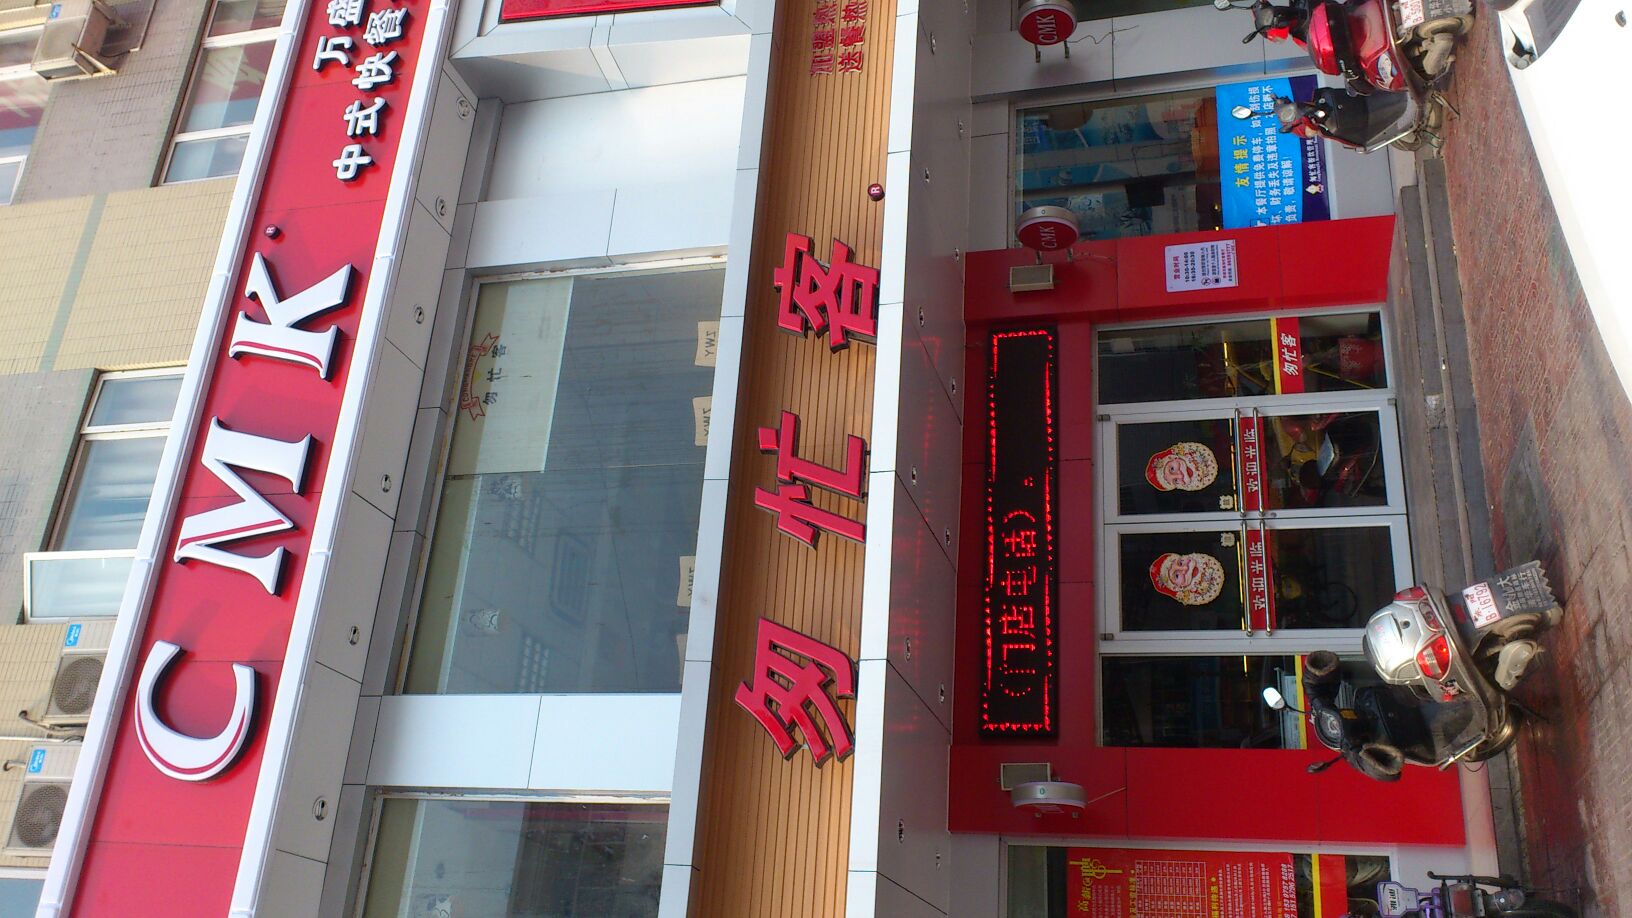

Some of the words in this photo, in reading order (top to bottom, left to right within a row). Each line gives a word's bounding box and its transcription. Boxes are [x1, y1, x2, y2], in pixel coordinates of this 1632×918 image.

[1035, 14, 1058, 44] CMK
[1233, 134, 1250, 188] 友情提示
[1037, 225, 1058, 249] CMK
[1280, 332, 1299, 376] 匆忙客
[1244, 428, 1259, 492] 欢迎光临
[135, 250, 357, 781] CMK
[734, 231, 881, 769] 匆忙客
[1250, 541, 1266, 610] 欢迎光临
